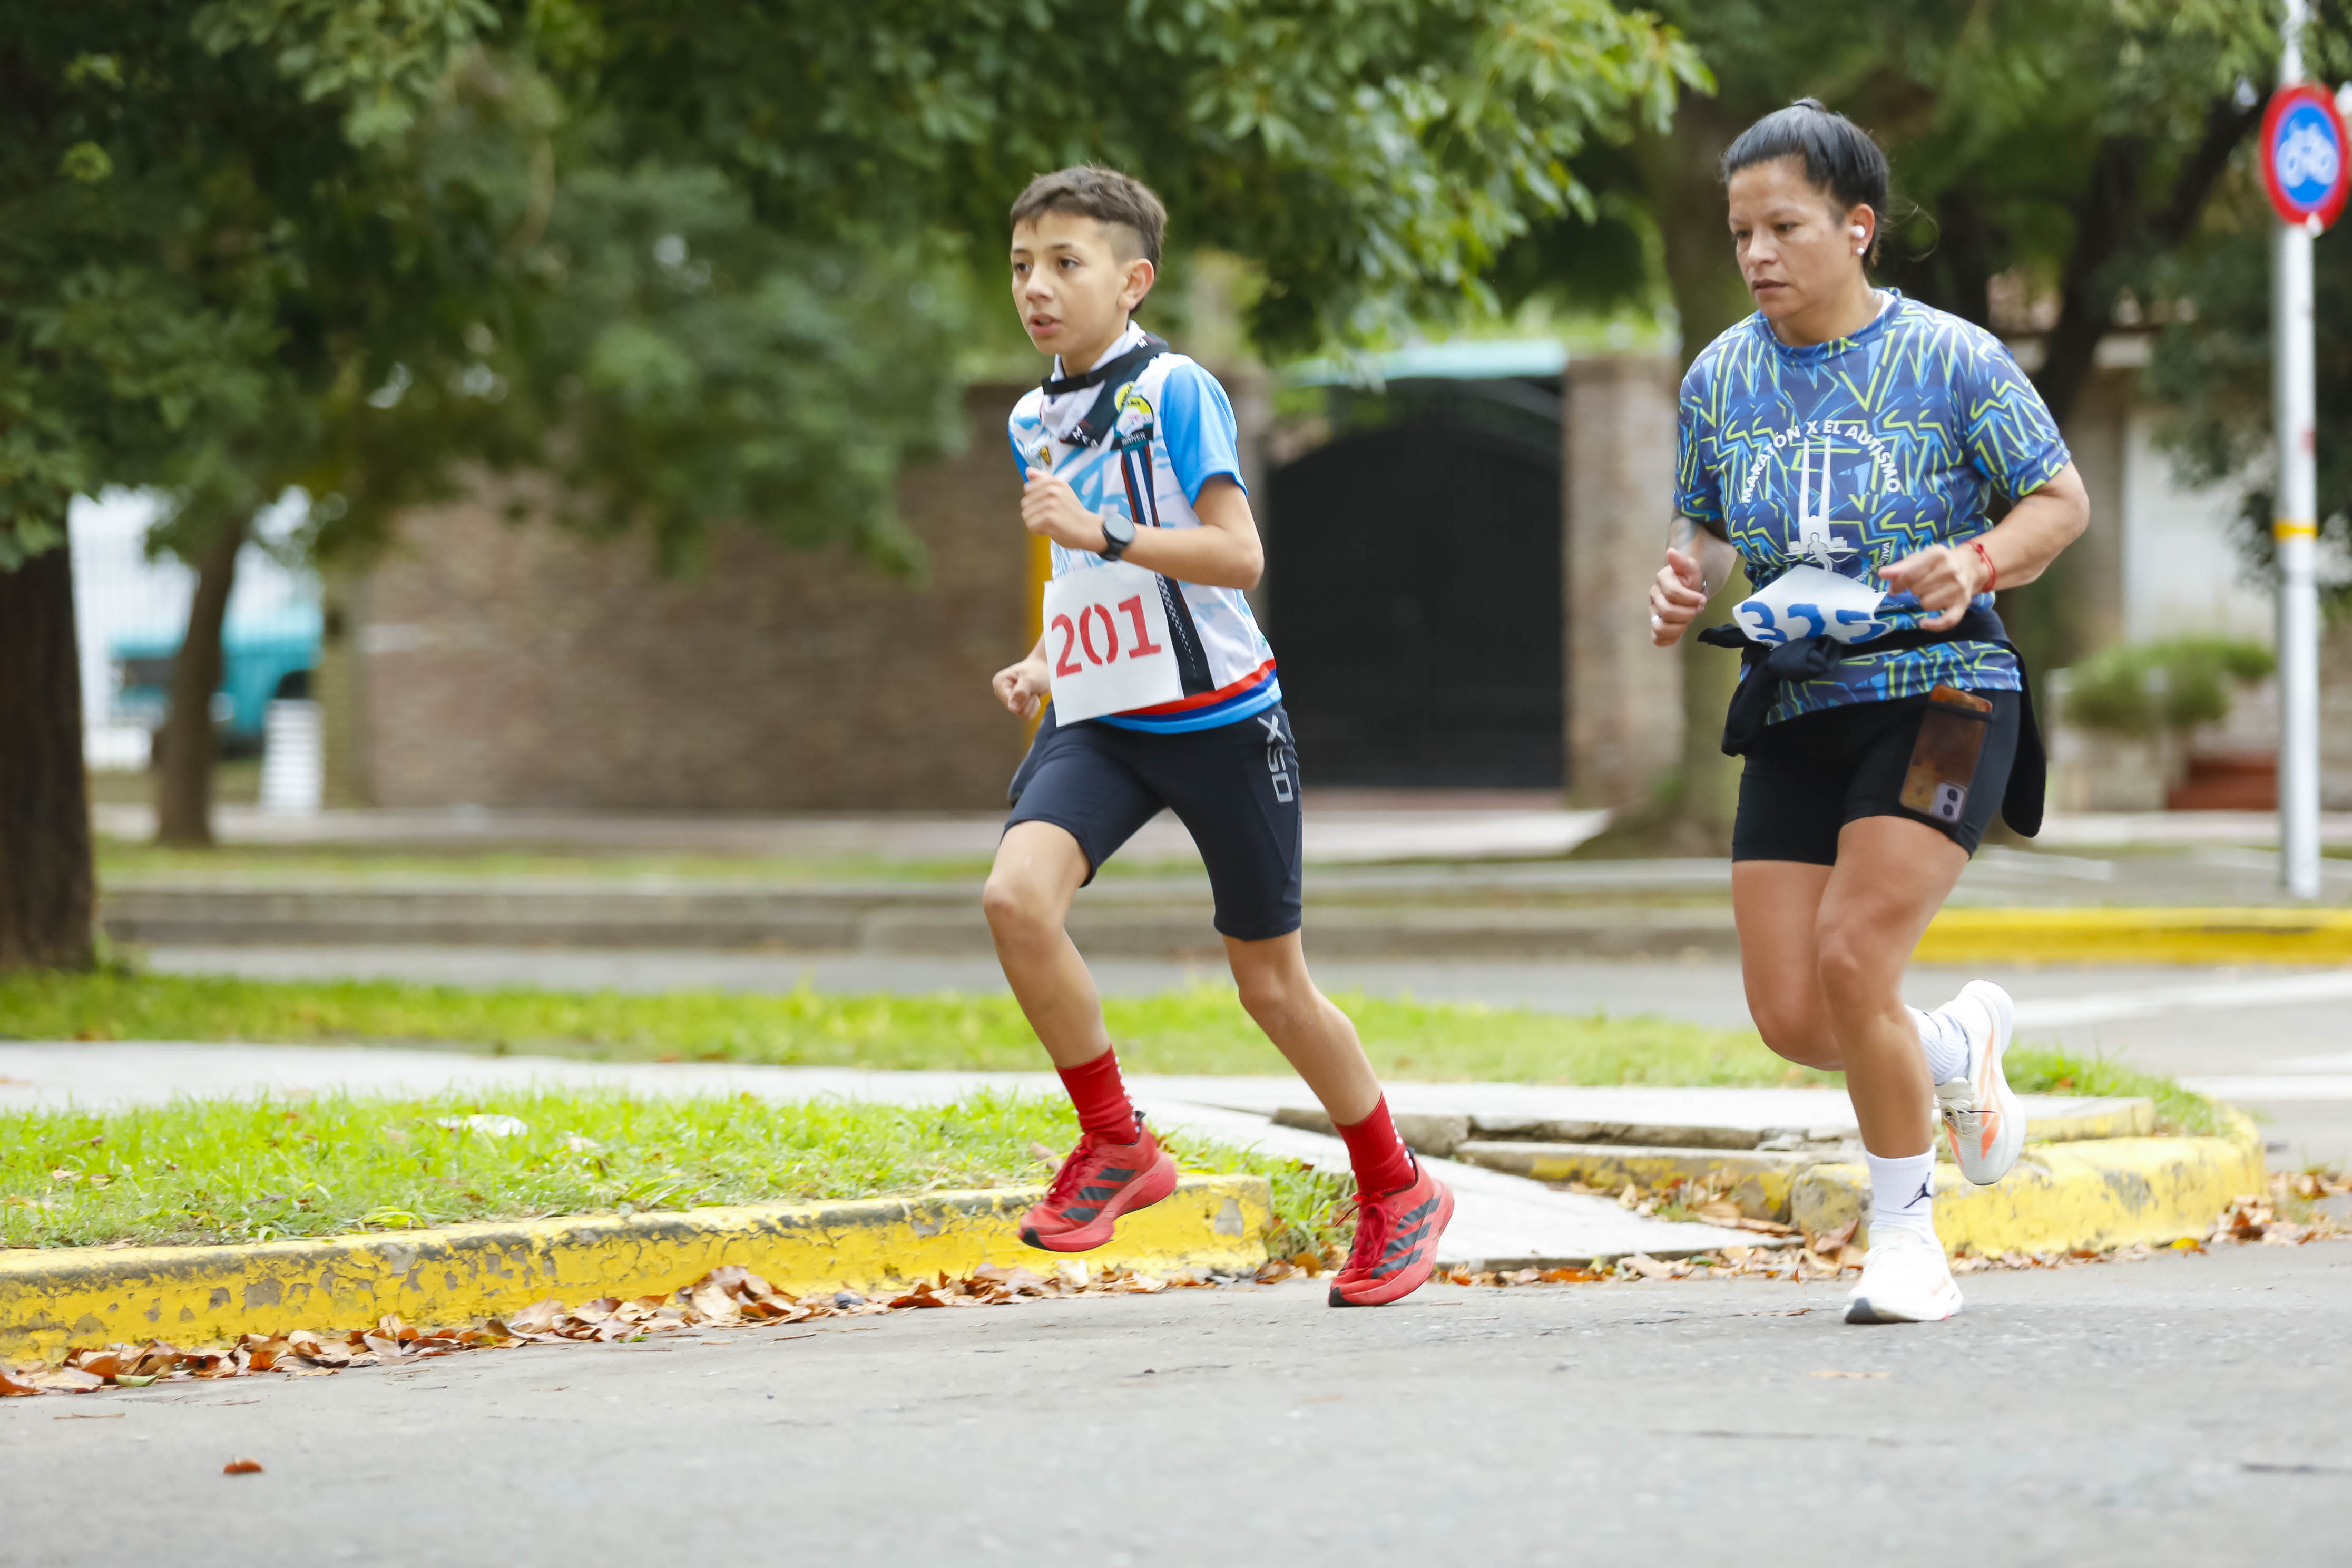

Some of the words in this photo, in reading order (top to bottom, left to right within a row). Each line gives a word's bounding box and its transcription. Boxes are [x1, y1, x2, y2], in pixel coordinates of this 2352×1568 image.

[1741, 429, 1801, 503] MARATÓN
[1806, 420, 1818, 434] X
[1823, 420, 1841, 434] EL
[1844, 425, 1902, 493] AUTISMO
[1051, 594, 1162, 678] 201
